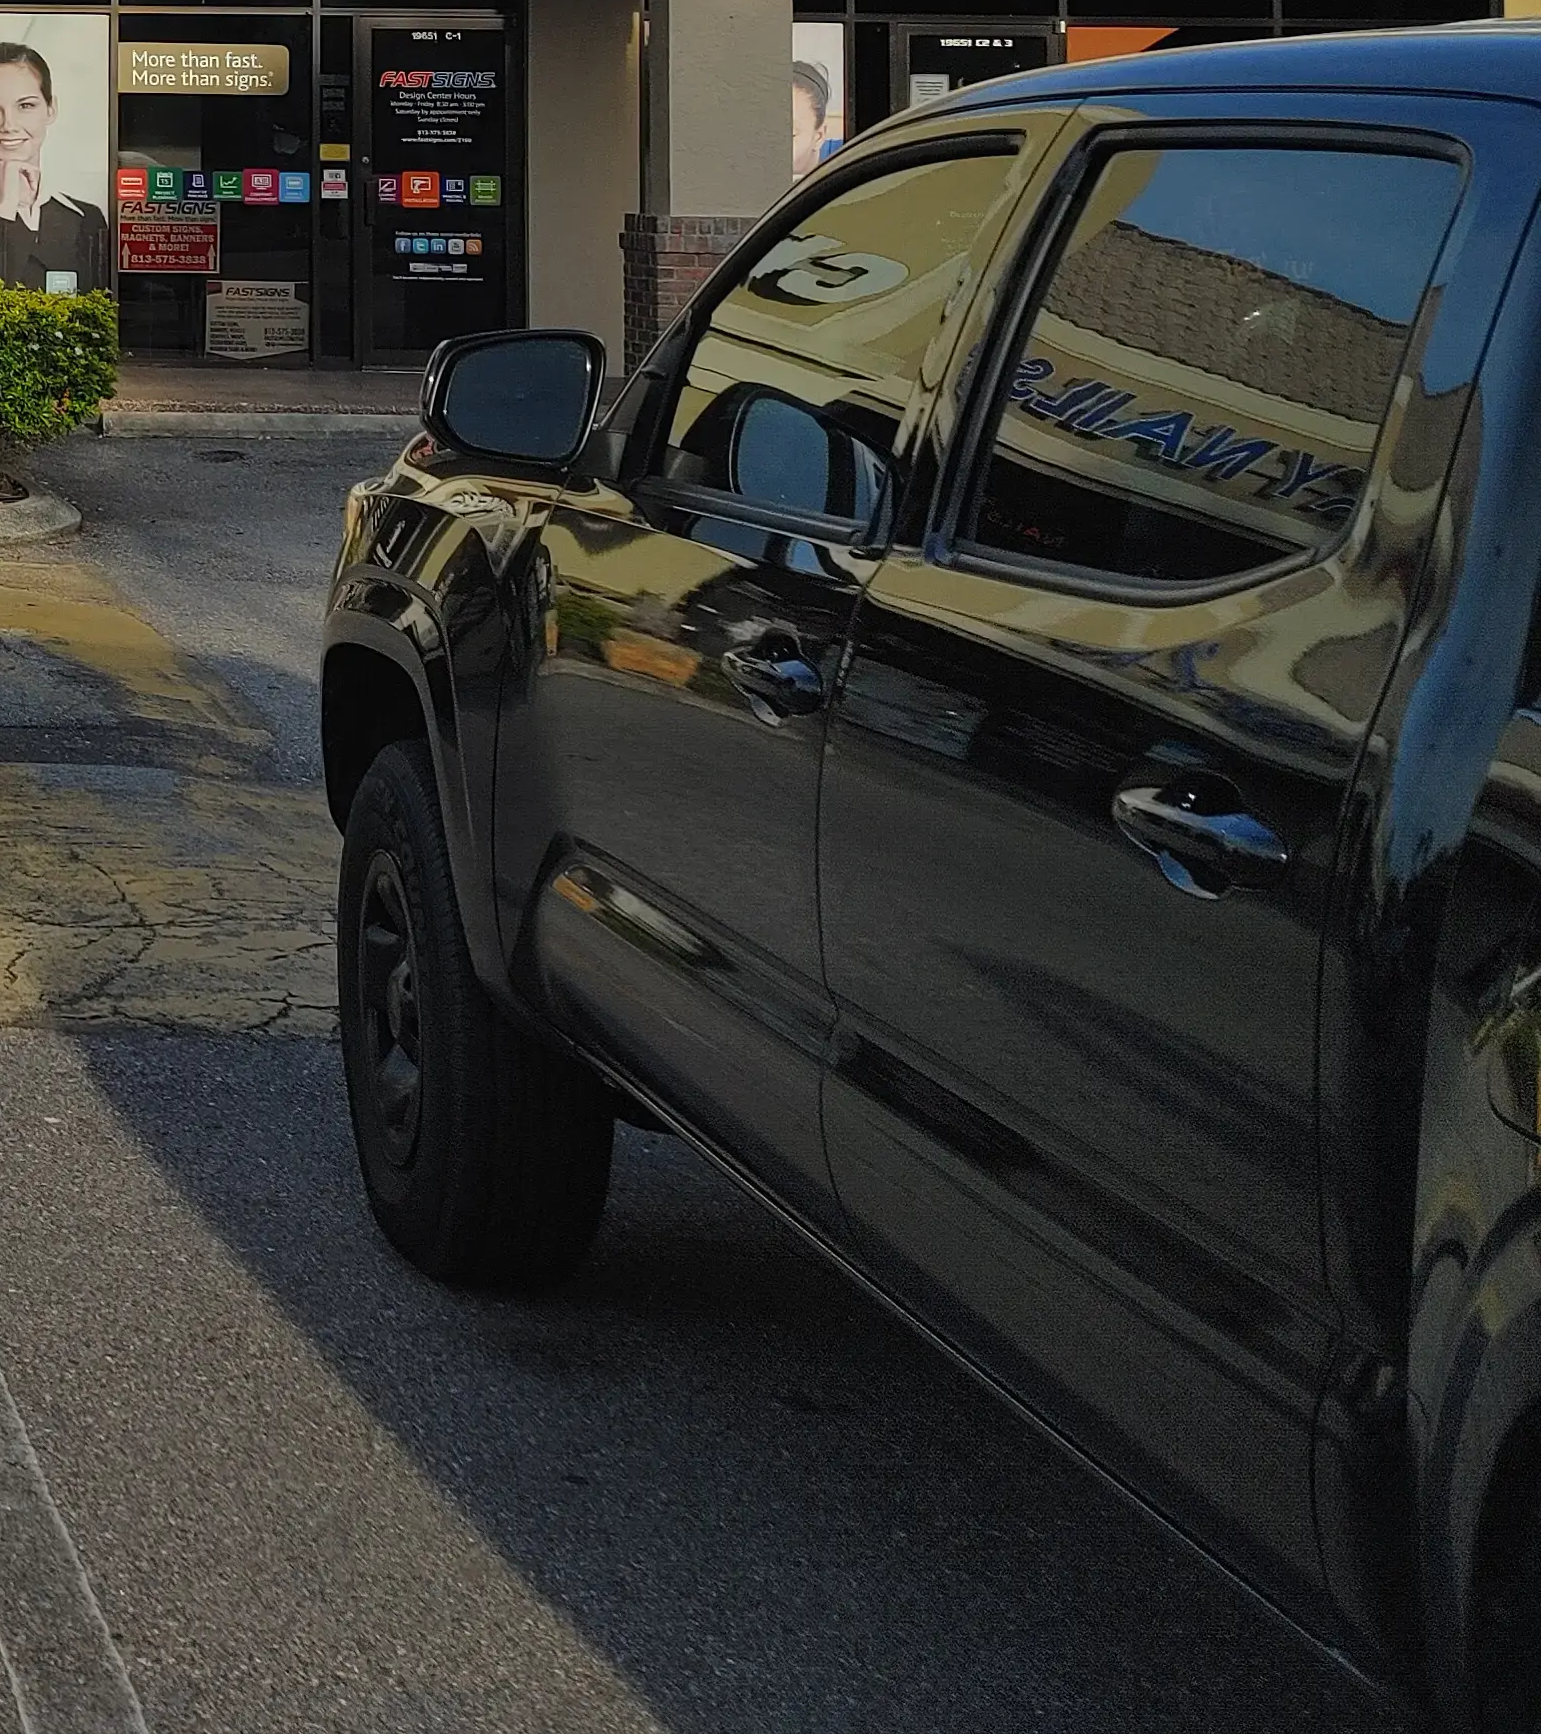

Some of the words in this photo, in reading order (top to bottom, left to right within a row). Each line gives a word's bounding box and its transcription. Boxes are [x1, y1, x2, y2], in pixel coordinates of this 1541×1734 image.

[132, 50, 176, 68] More
[181, 50, 219, 68] than
[225, 51, 263, 68] fast.
[132, 69, 176, 86] More
[181, 69, 219, 86] than
[379, 71, 496, 88] FASTSIGNS
[399, 92, 425, 101] Design
[454, 92, 476, 100] Hours
[121, 201, 216, 215] FASTSIGNS
[132, 225, 170, 233] CUSTOM
[226, 287, 290, 297] FASTSIGNS
